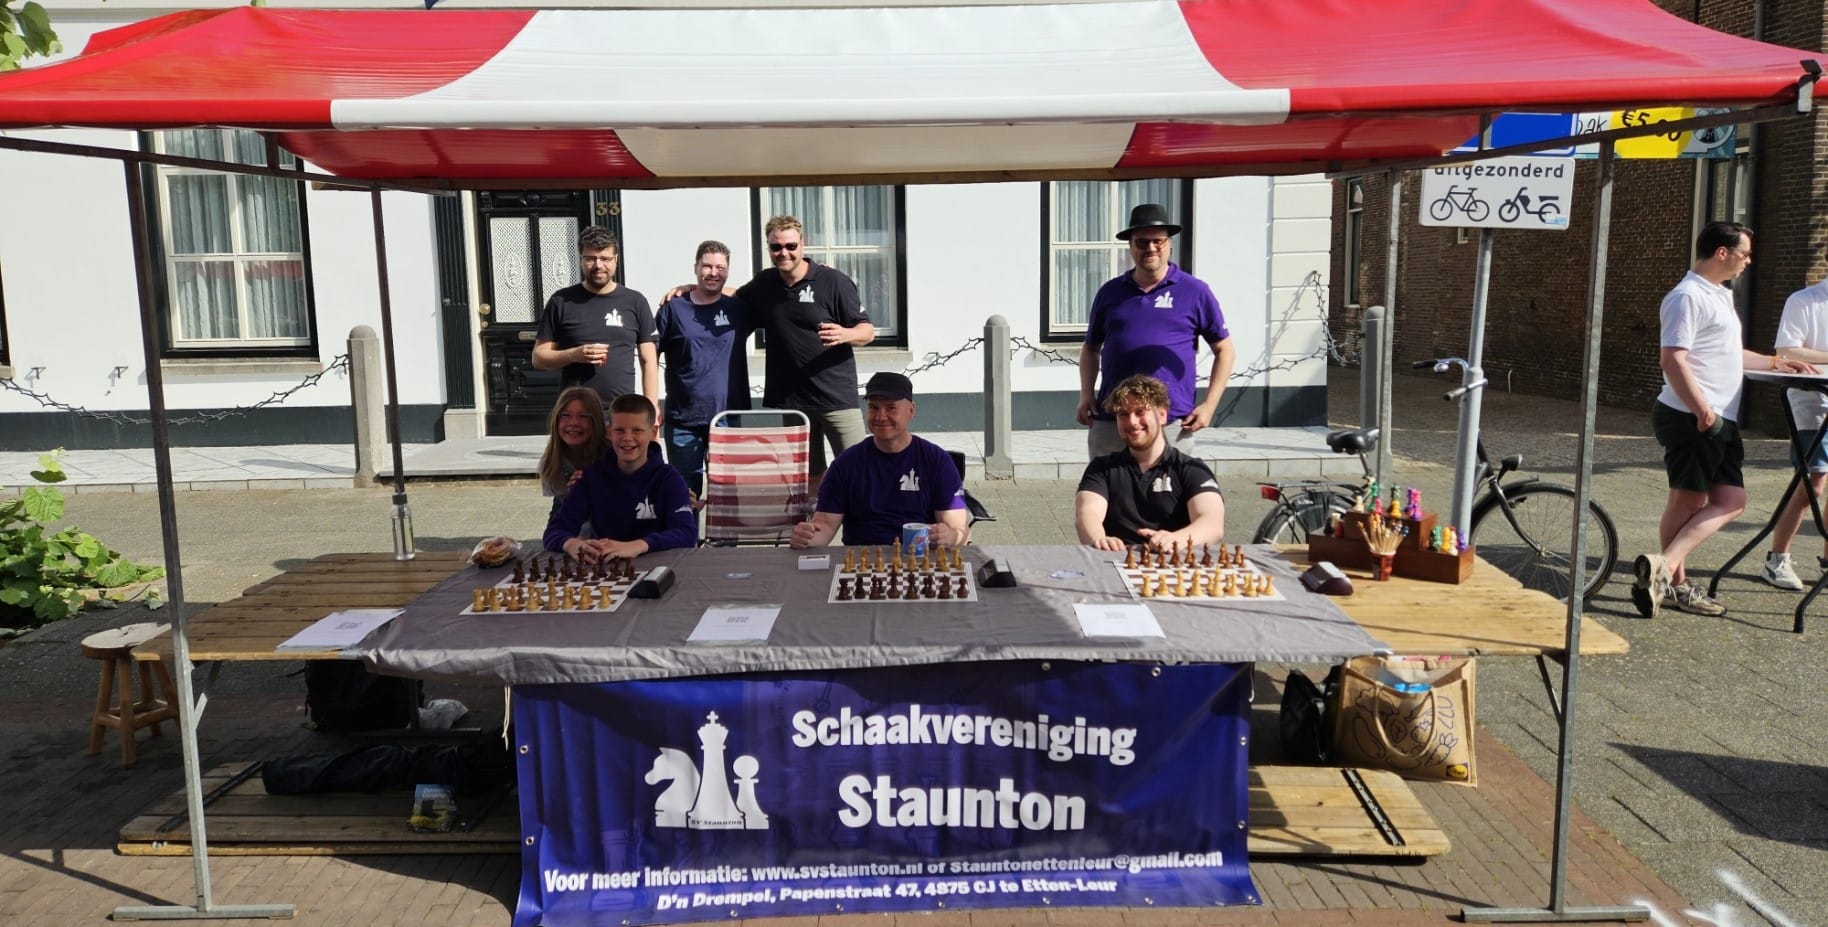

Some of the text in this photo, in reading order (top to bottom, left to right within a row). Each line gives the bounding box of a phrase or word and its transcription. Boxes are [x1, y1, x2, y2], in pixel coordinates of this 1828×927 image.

[791, 704, 1137, 766] Schaakvereniging
[838, 774, 1086, 831] Staunton
[544, 850, 1223, 893] Voor meer informatie: www.svstaunton.nl of Stauntonettenleur@gmail.com
[656, 877, 1118, 911] D'n Drempel, Papenstraat 47, 4875 CJ te Etten-Leur
